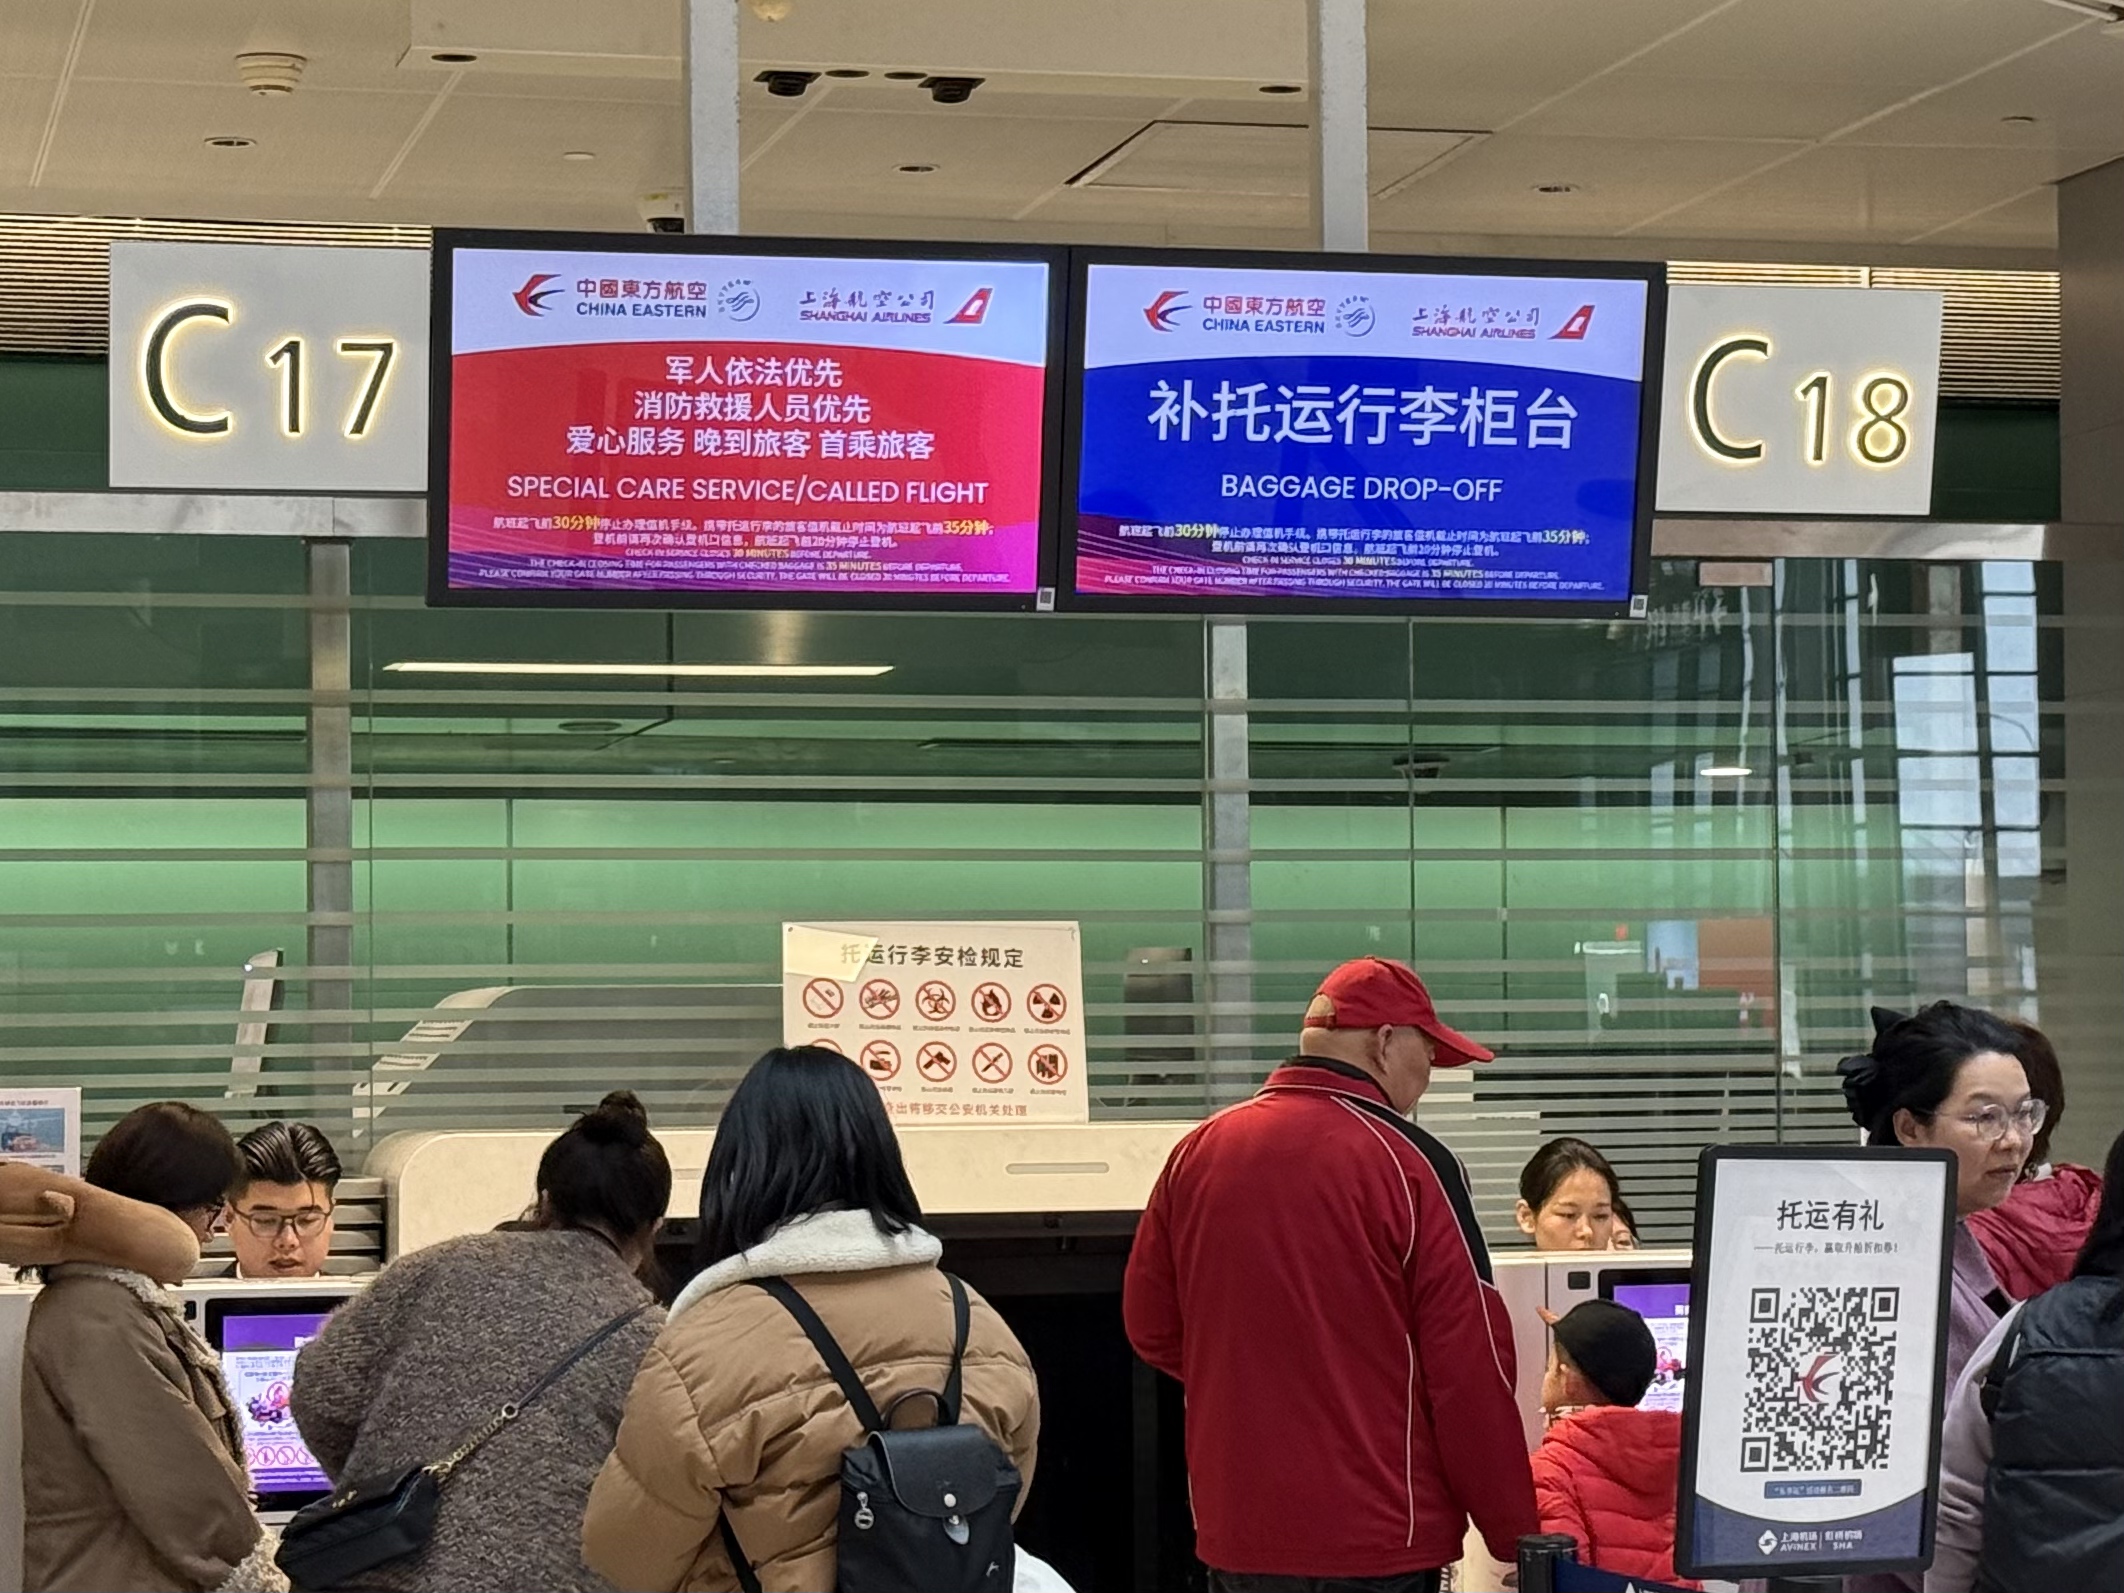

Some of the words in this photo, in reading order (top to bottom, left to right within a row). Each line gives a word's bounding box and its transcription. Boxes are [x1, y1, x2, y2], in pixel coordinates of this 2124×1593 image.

[577, 278, 707, 300] 中國東方航空
[800, 287, 934, 308] 上海航空公司
[576, 302, 627, 316] CHINA
[632, 304, 706, 318] EASTERN
[799, 311, 867, 322] SHANGHAI
[871, 312, 931, 323] AIRLINES
[1203, 296, 1326, 317] 中國東方航空
[1412, 304, 1539, 326] 上海航空公司
[1202, 318, 1250, 331] CHINA
[1254, 320, 1325, 334] EASTERN
[1412, 326, 1476, 337] SHANGHAI
[1480, 327, 1536, 339] AIRLINES
[665, 356, 843, 387] 军人依法优先
[634, 390, 871, 423] 消防救援人员优先
[1147, 379, 1578, 449] 补托运行李柜台
[566, 425, 685, 457] 爱心服务
[693, 429, 810, 459] 晚到旅客
[819, 429, 935, 460] 首乘旅客
[507, 476, 609, 499] SPECIAL
[616, 477, 684, 500] CARE
[692, 475, 899, 505] SERVICE/CALLED
[905, 481, 989, 504] FLIGHT
[1221, 474, 1356, 499] BAGGAGE
[1363, 476, 1504, 502] DROP-OFF
[746, 550, 789, 558] MINUTES
[1355, 557, 1396, 566] MINUTES
[839, 562, 881, 571] MINUTES
[1443, 570, 1483, 578] MINUTES
[1777, 1199, 1884, 1231] 托运有礼
